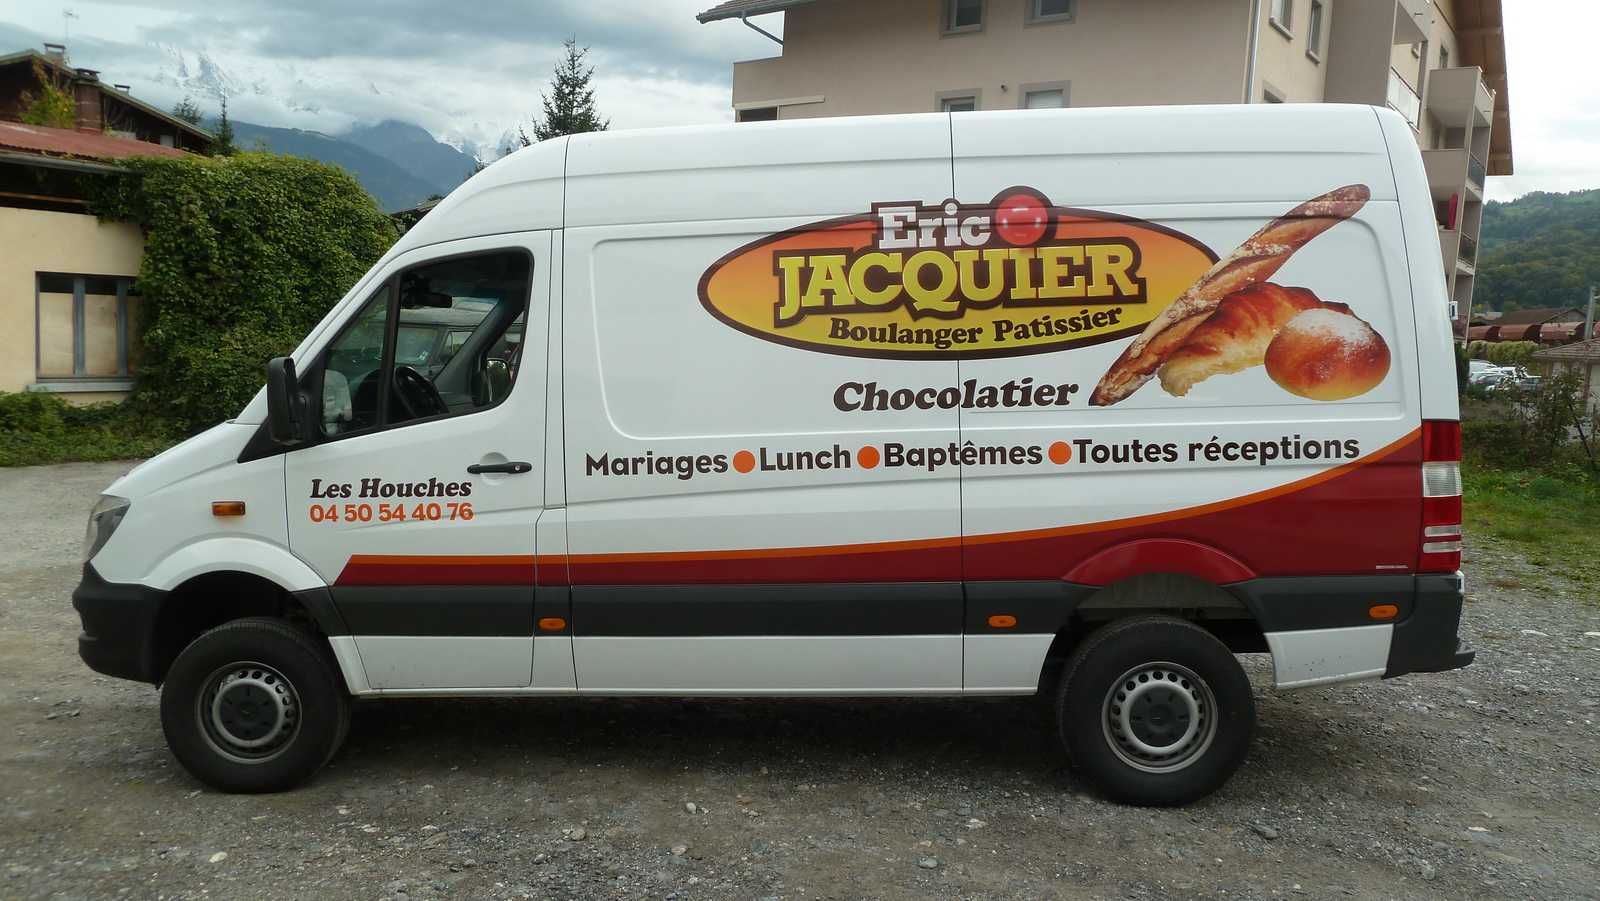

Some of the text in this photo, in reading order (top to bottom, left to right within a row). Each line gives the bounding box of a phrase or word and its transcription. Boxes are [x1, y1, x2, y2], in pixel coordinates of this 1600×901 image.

[878, 202, 992, 249] Eric
[778, 244, 1140, 320] JACQUIER
[829, 304, 1124, 349] Boulanger Patissier
[833, 377, 1079, 412] Chocolatier
[586, 434, 1360, 480] Mariages Lunch Baptêmes Toutes réceptions
[310, 477, 472, 498] Les Houches
[309, 502, 474, 523] 04 50 54 40 76
